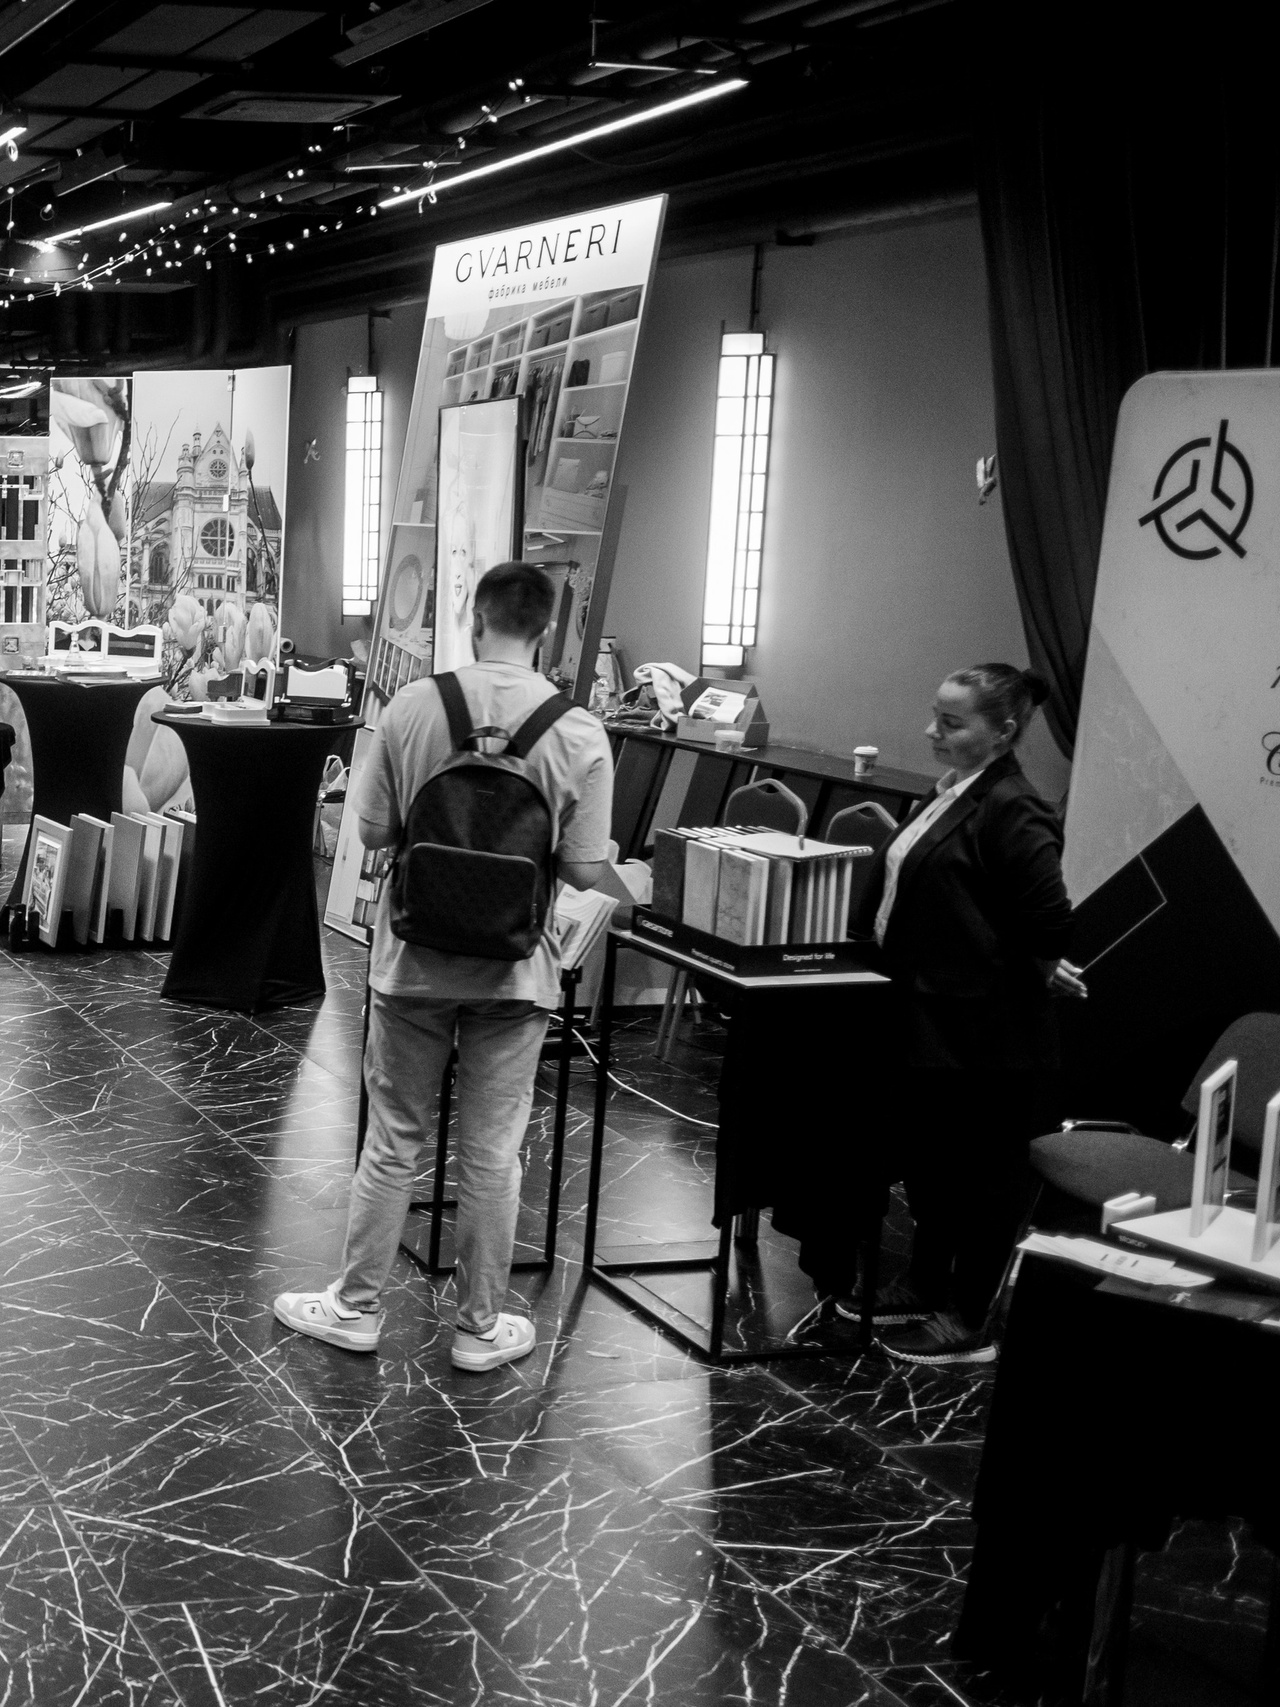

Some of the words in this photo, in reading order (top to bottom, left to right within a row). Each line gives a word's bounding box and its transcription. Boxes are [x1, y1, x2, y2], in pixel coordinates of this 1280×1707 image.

[455, 219, 623, 283] GVARNERI
[488, 282, 527, 302] фабрика
[532, 276, 568, 292] мебели
